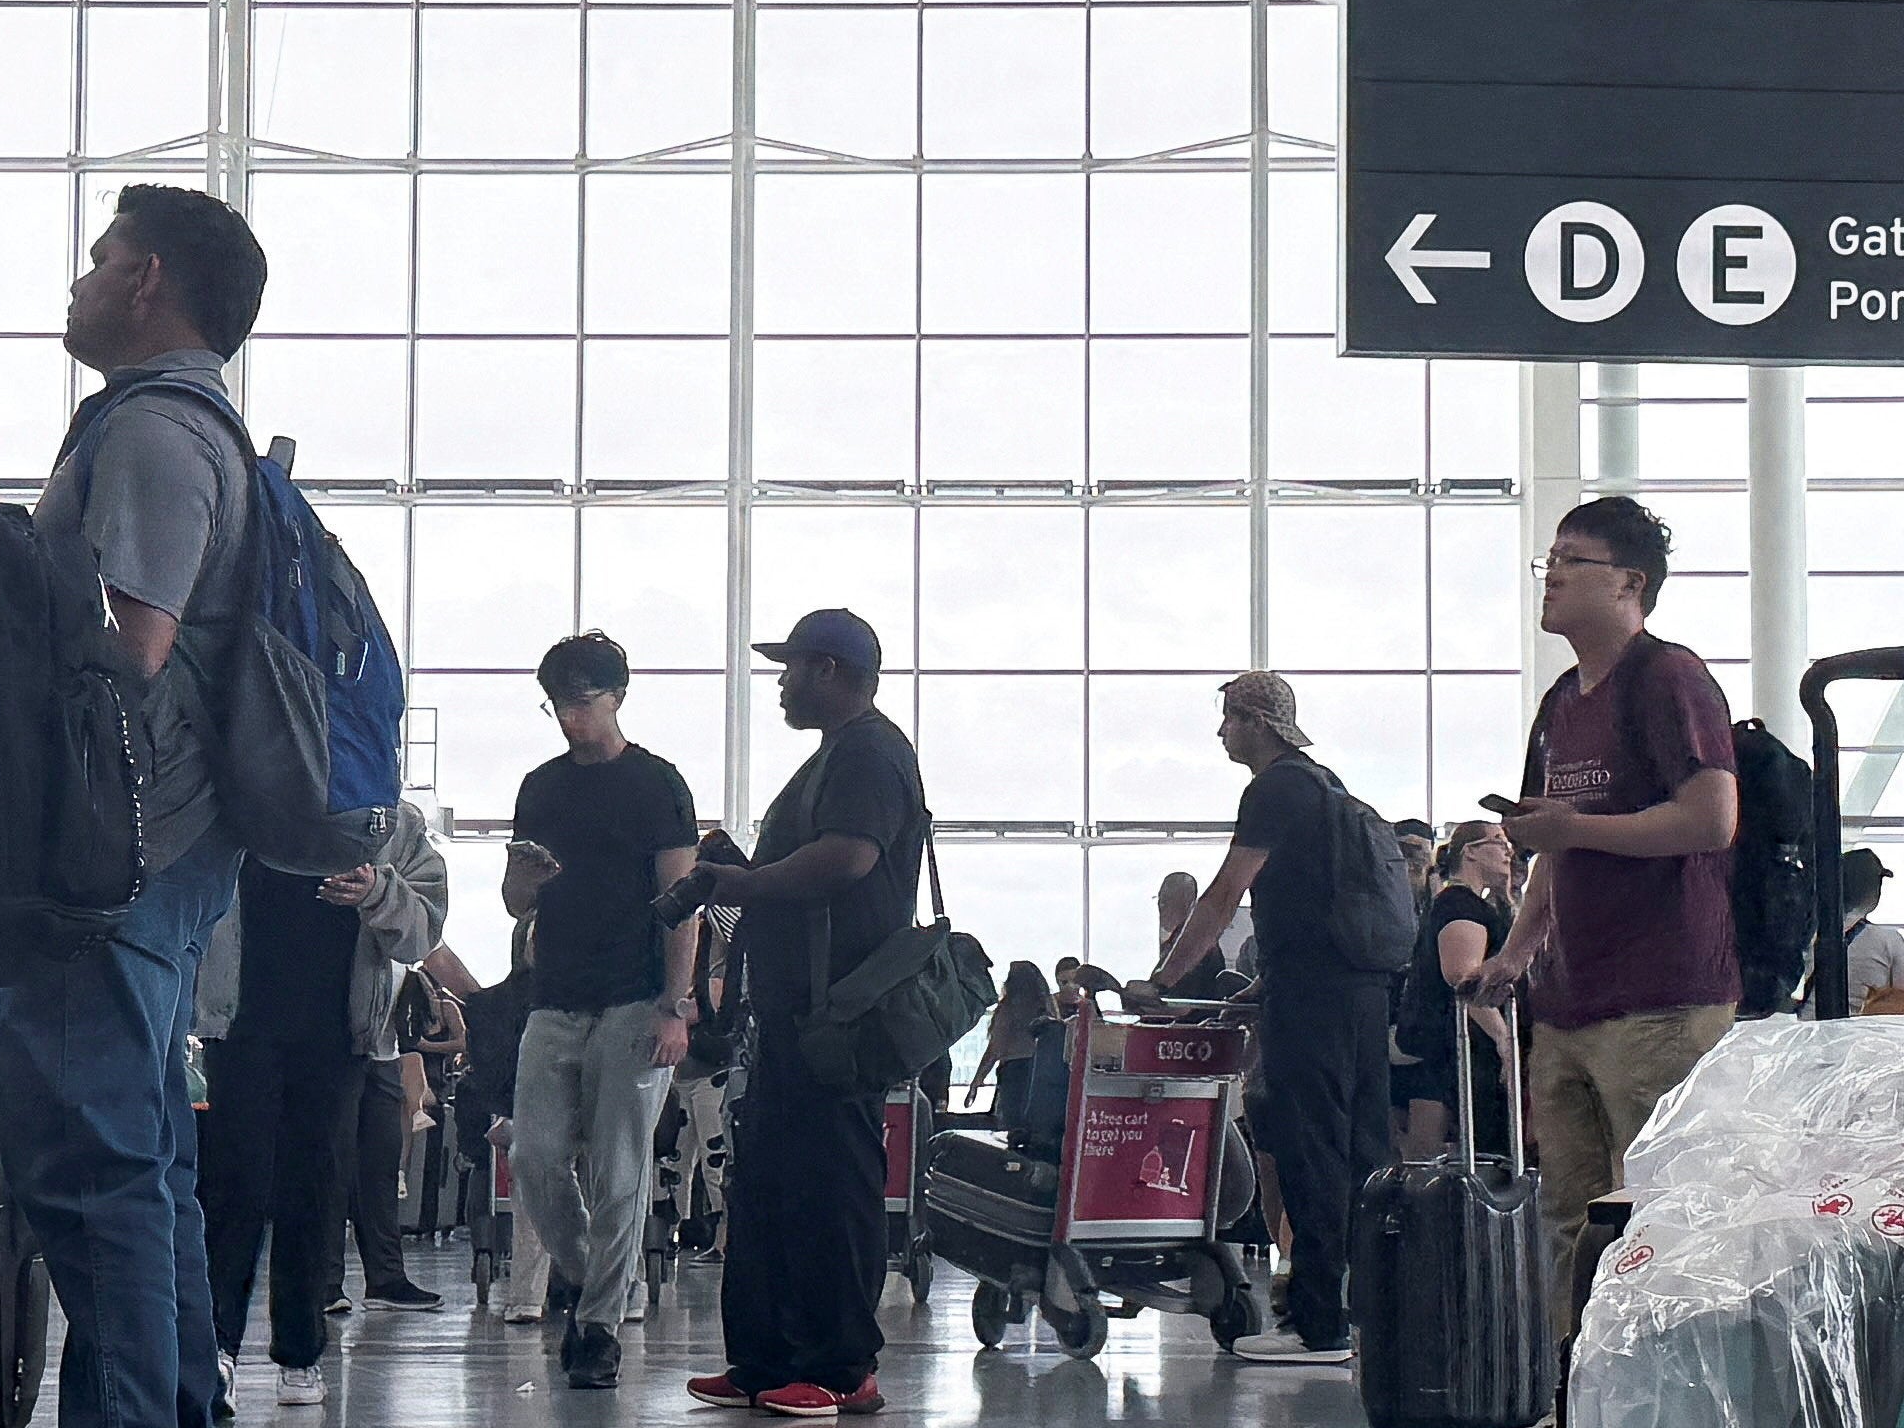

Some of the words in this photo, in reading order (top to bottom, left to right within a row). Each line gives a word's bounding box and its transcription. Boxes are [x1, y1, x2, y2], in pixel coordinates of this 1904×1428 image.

[1559, 221, 1620, 301] D
[1712, 224, 1765, 306] E
[1124, 1111, 1148, 1125] cart
[1121, 1130, 1143, 1145] you
